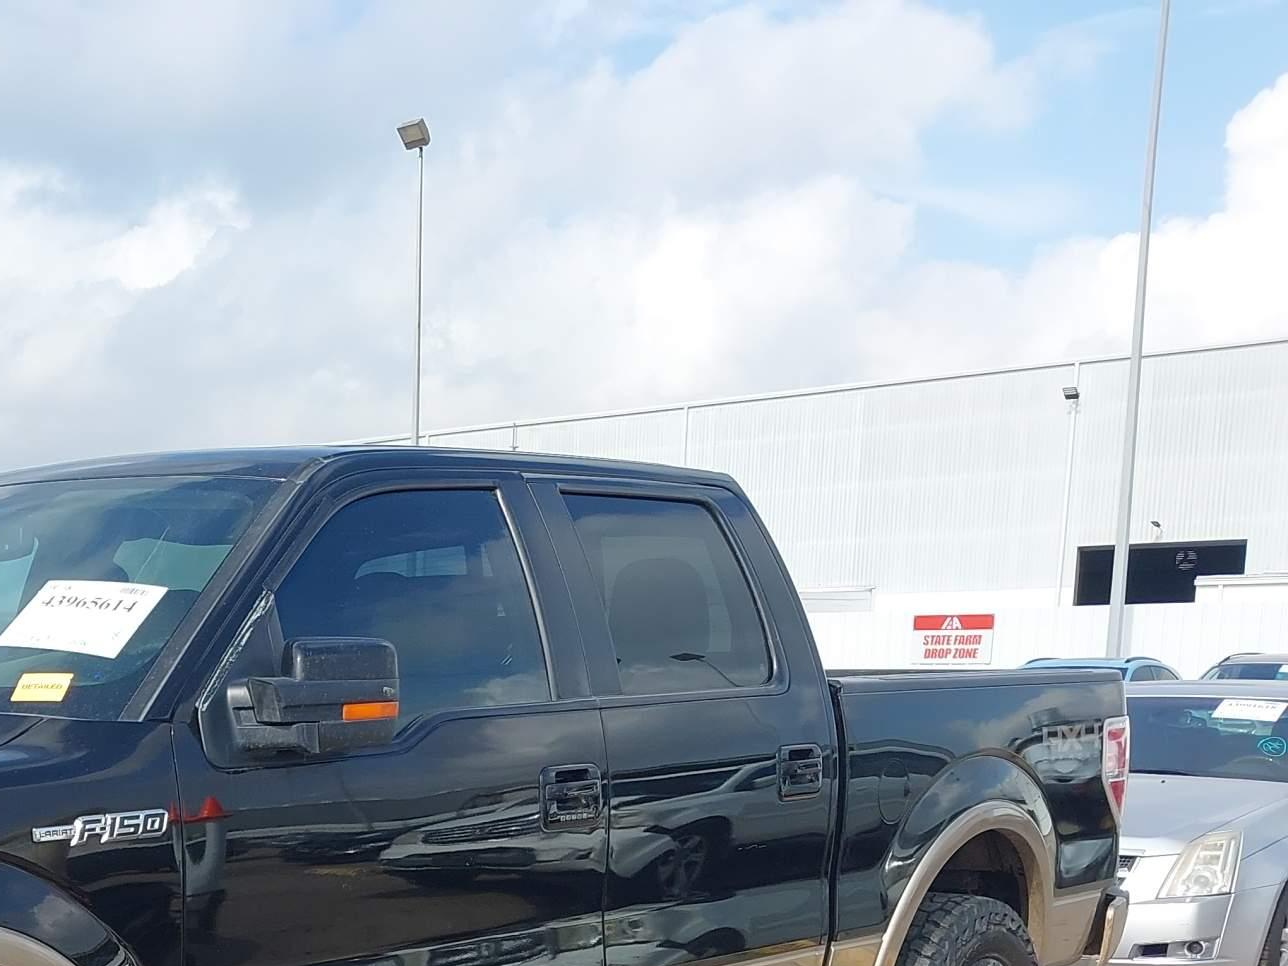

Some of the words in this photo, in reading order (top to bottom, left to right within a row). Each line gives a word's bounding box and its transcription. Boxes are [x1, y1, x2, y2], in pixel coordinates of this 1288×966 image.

[41, 595, 139, 613] 43965614
[923, 634, 952, 646] STATE
[953, 634, 983, 646] FARM
[924, 648, 952, 659] DROP
[952, 648, 979, 659] ZONE
